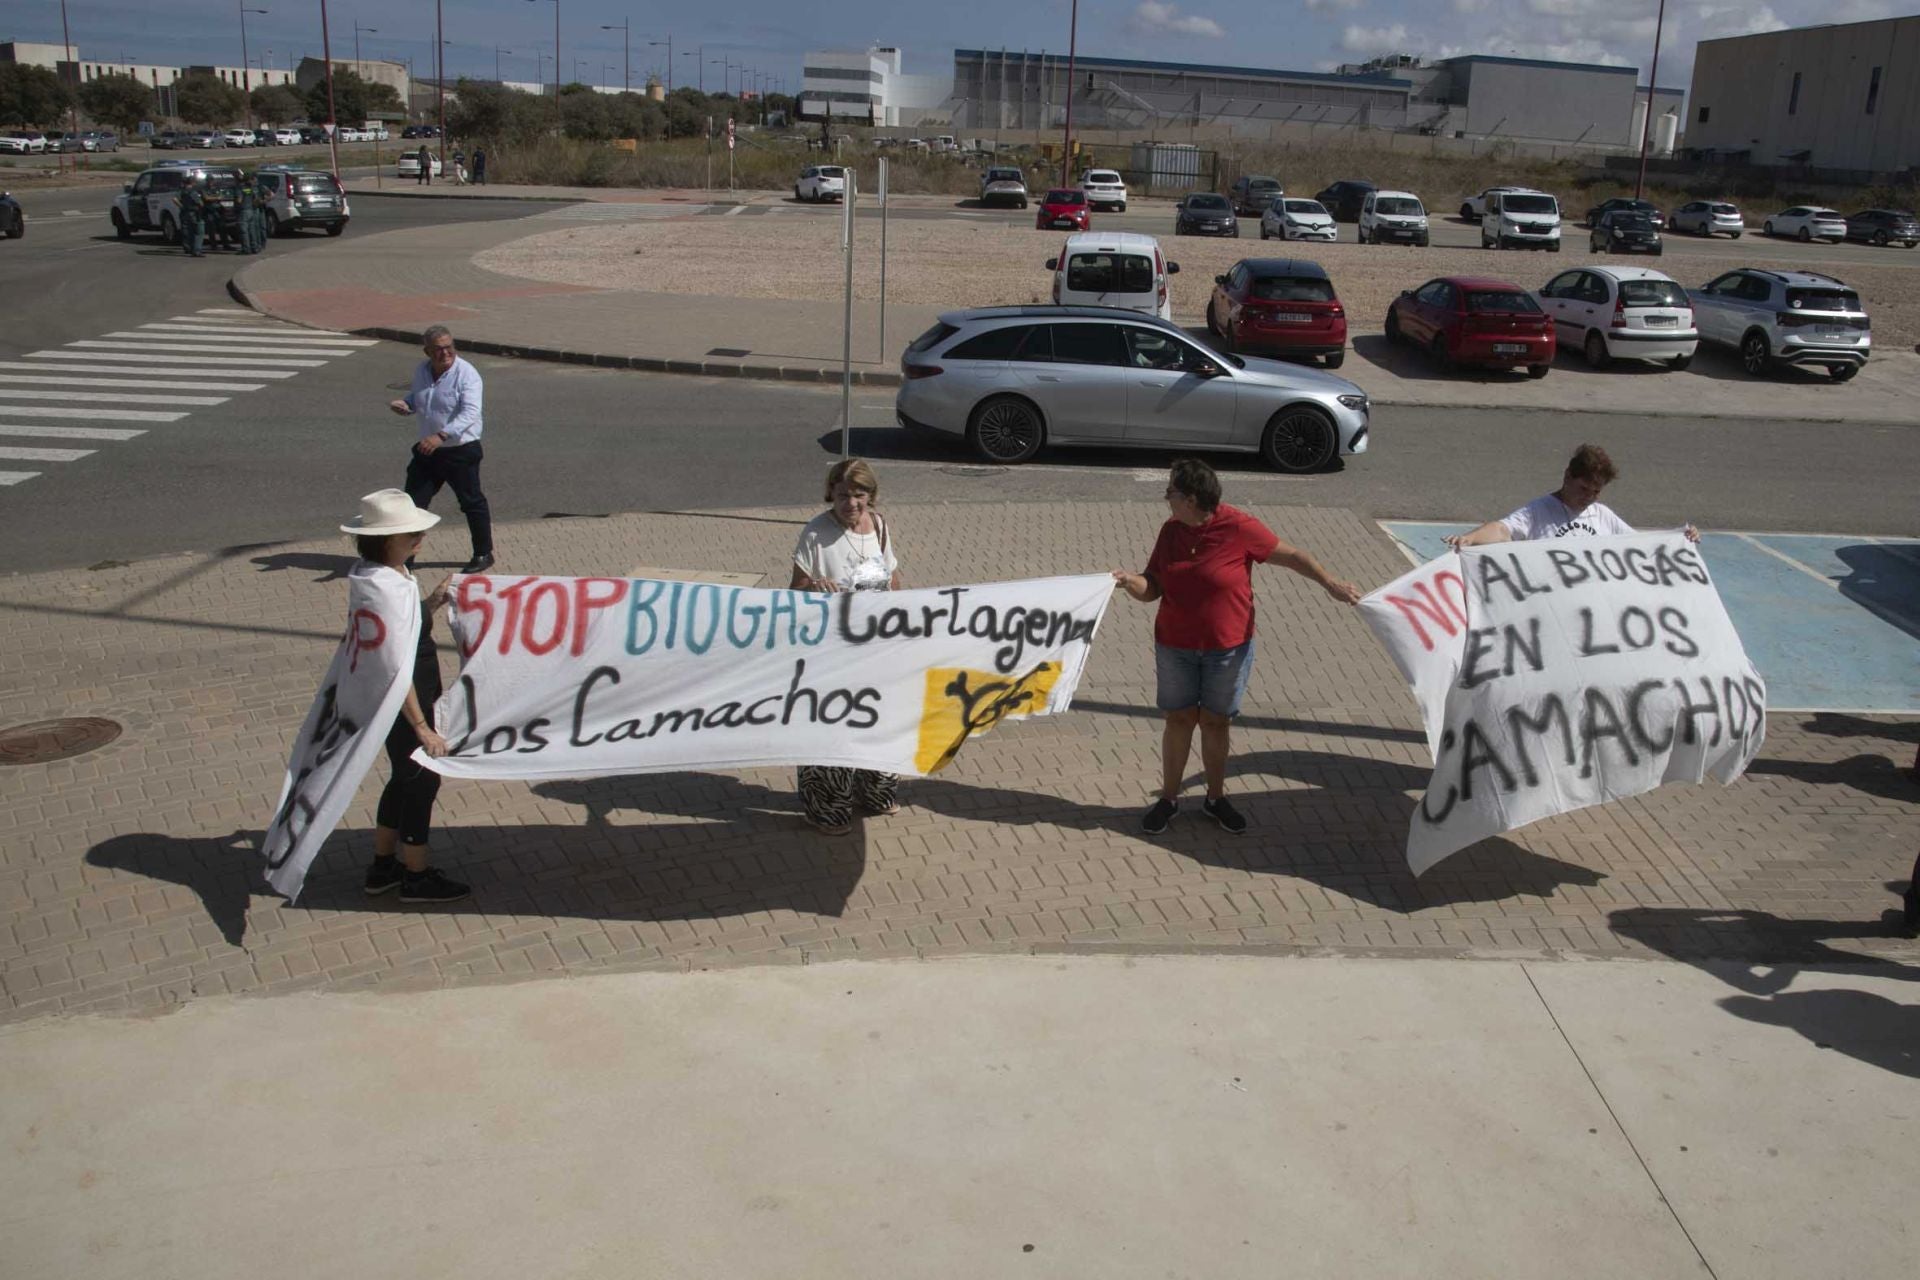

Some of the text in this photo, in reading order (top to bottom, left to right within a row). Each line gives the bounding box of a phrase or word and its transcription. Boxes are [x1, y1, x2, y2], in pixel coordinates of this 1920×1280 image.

[457, 575, 630, 658] STOP
[624, 578, 831, 656] BIOGAS
[1386, 570, 1468, 652] NO
[1478, 552, 1552, 603] AL
[1457, 605, 1700, 689] EN LOS
[447, 658, 882, 758] Los Camachos
[1422, 675, 1765, 825] CAMACHOS
